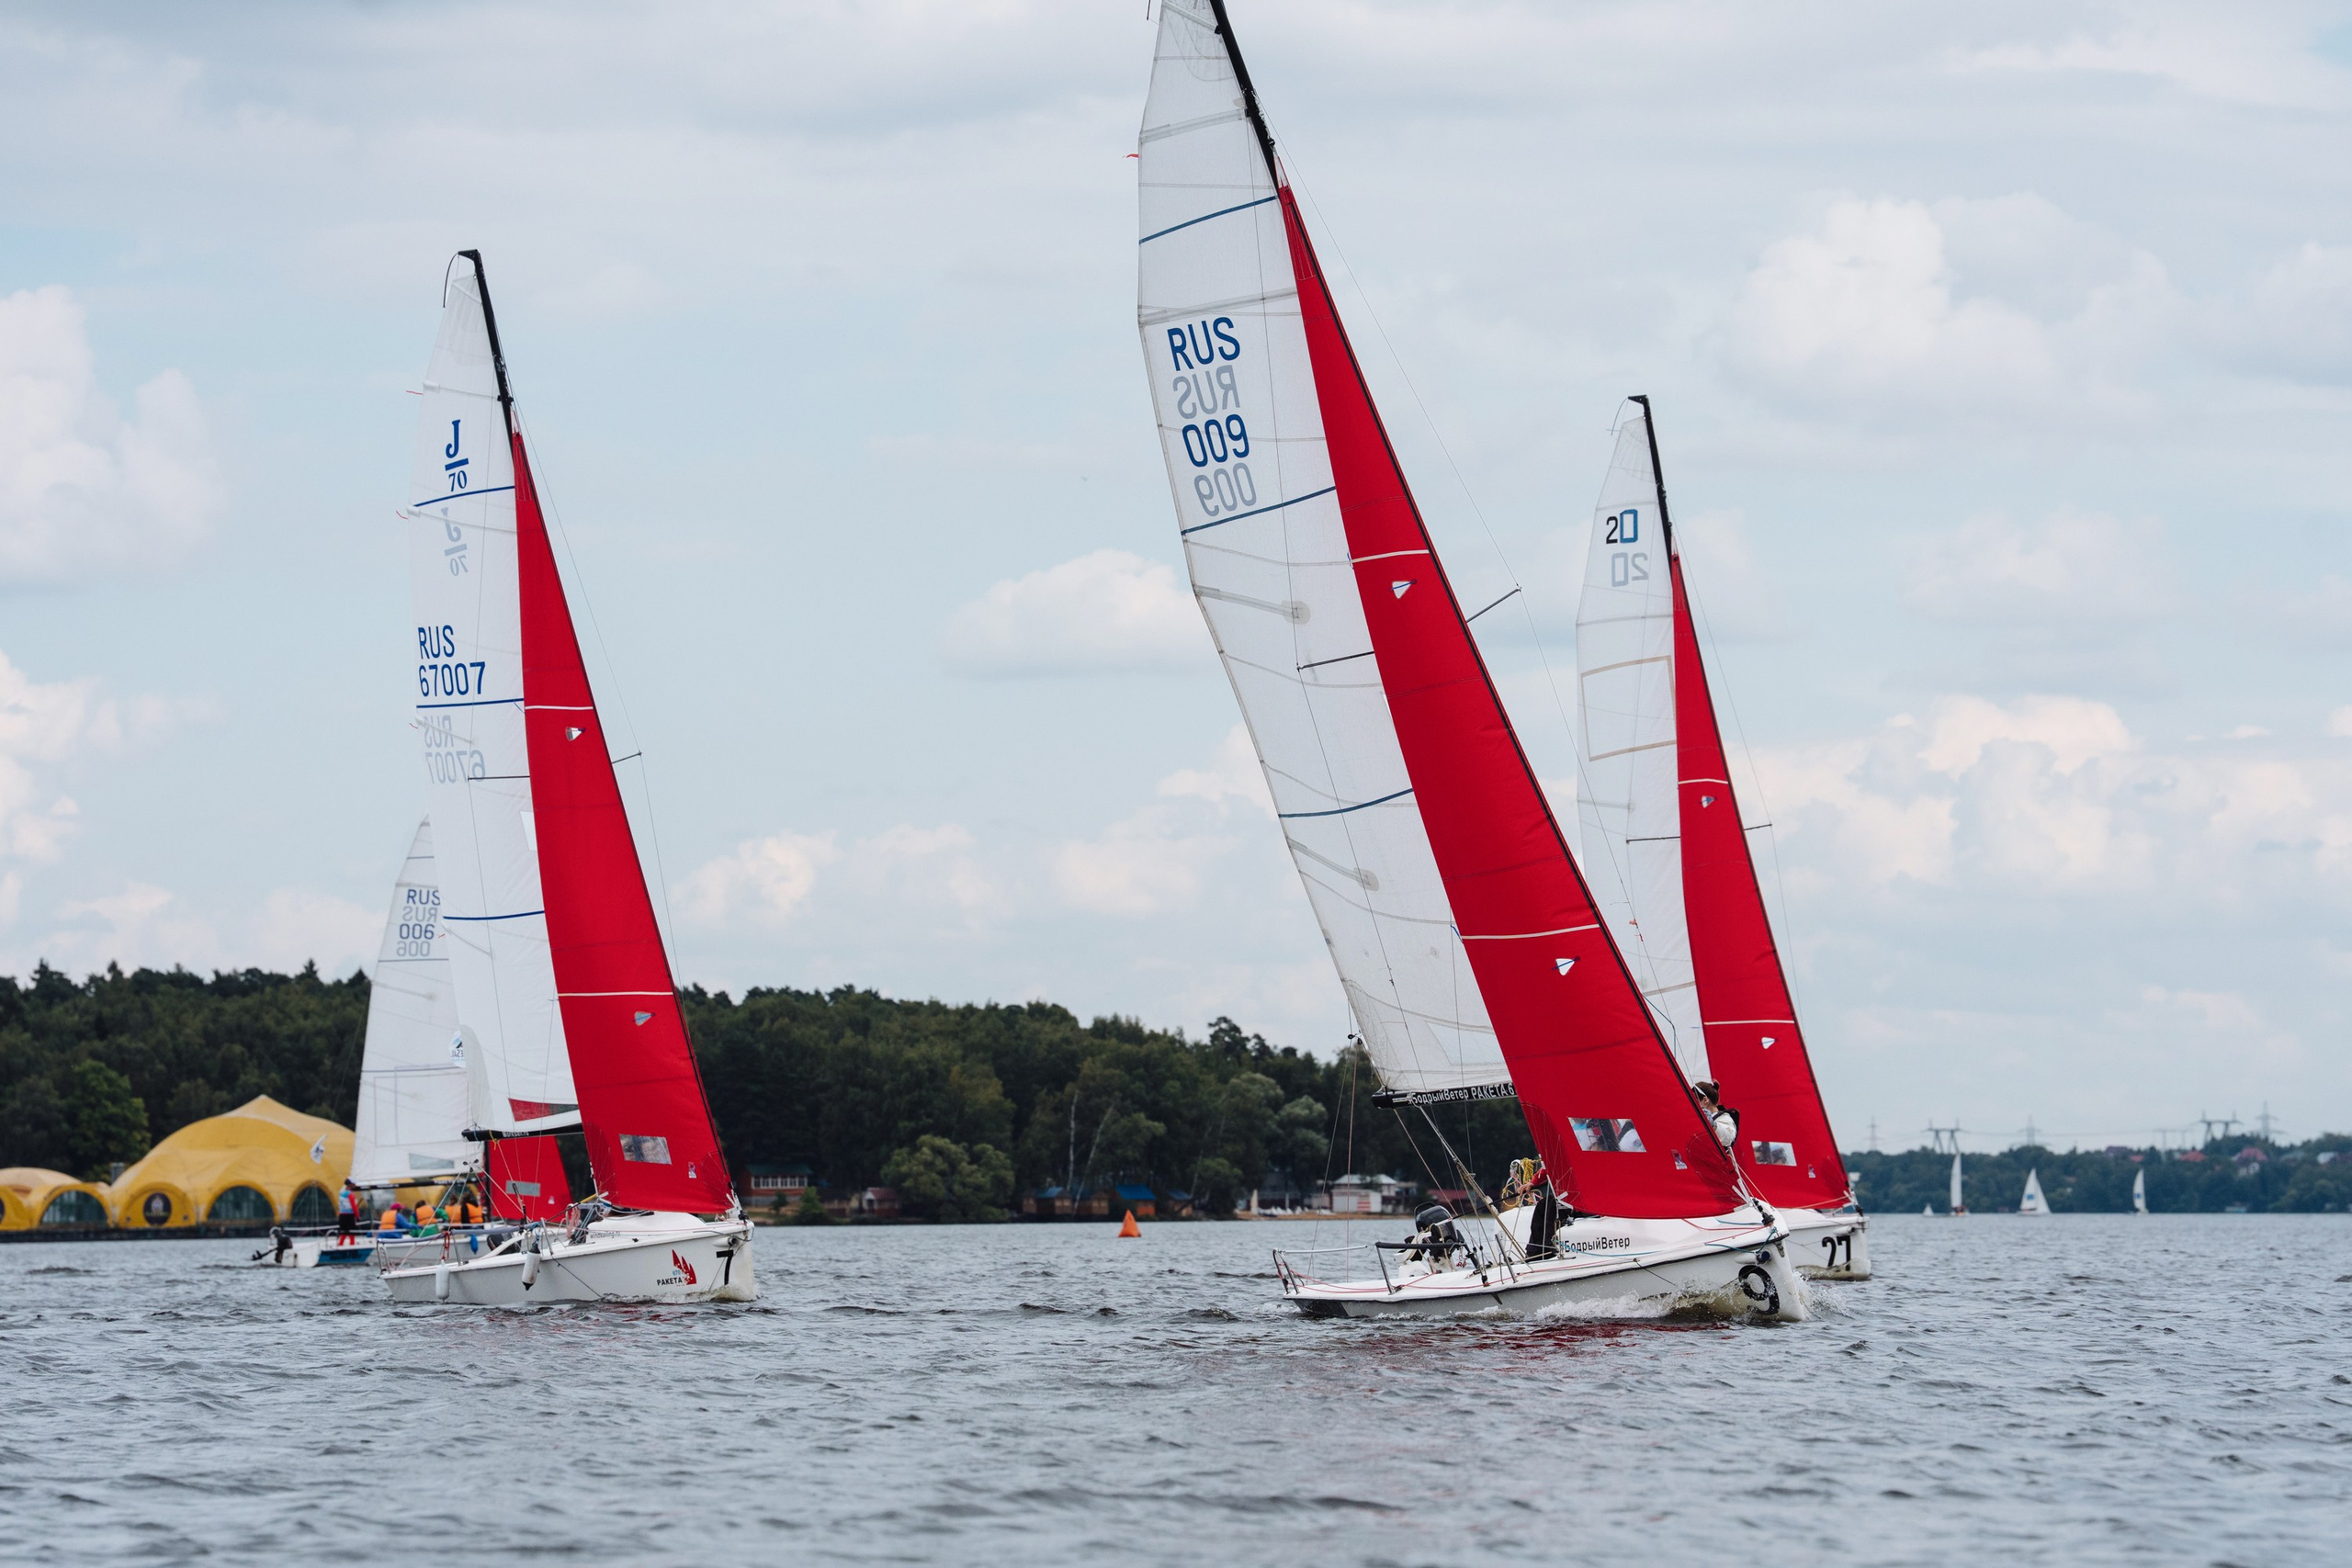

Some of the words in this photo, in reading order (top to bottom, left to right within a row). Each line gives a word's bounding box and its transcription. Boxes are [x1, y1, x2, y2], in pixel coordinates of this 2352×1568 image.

[1167, 317, 1240, 371] RUS
[445, 419, 461, 458] J
[1182, 414, 1250, 468] 009
[448, 470, 468, 492] 70
[1606, 509, 1638, 544] 20
[418, 625, 455, 660] RUS
[418, 661, 486, 698] 67007
[406, 889, 441, 906] RUS
[400, 924, 435, 940] 006
[1471, 1083, 1508, 1100] РАКЕТА
[716, 1249, 734, 1286] 7
[1822, 1235, 1851, 1271] 27
[1738, 1265, 1780, 1315] 9
